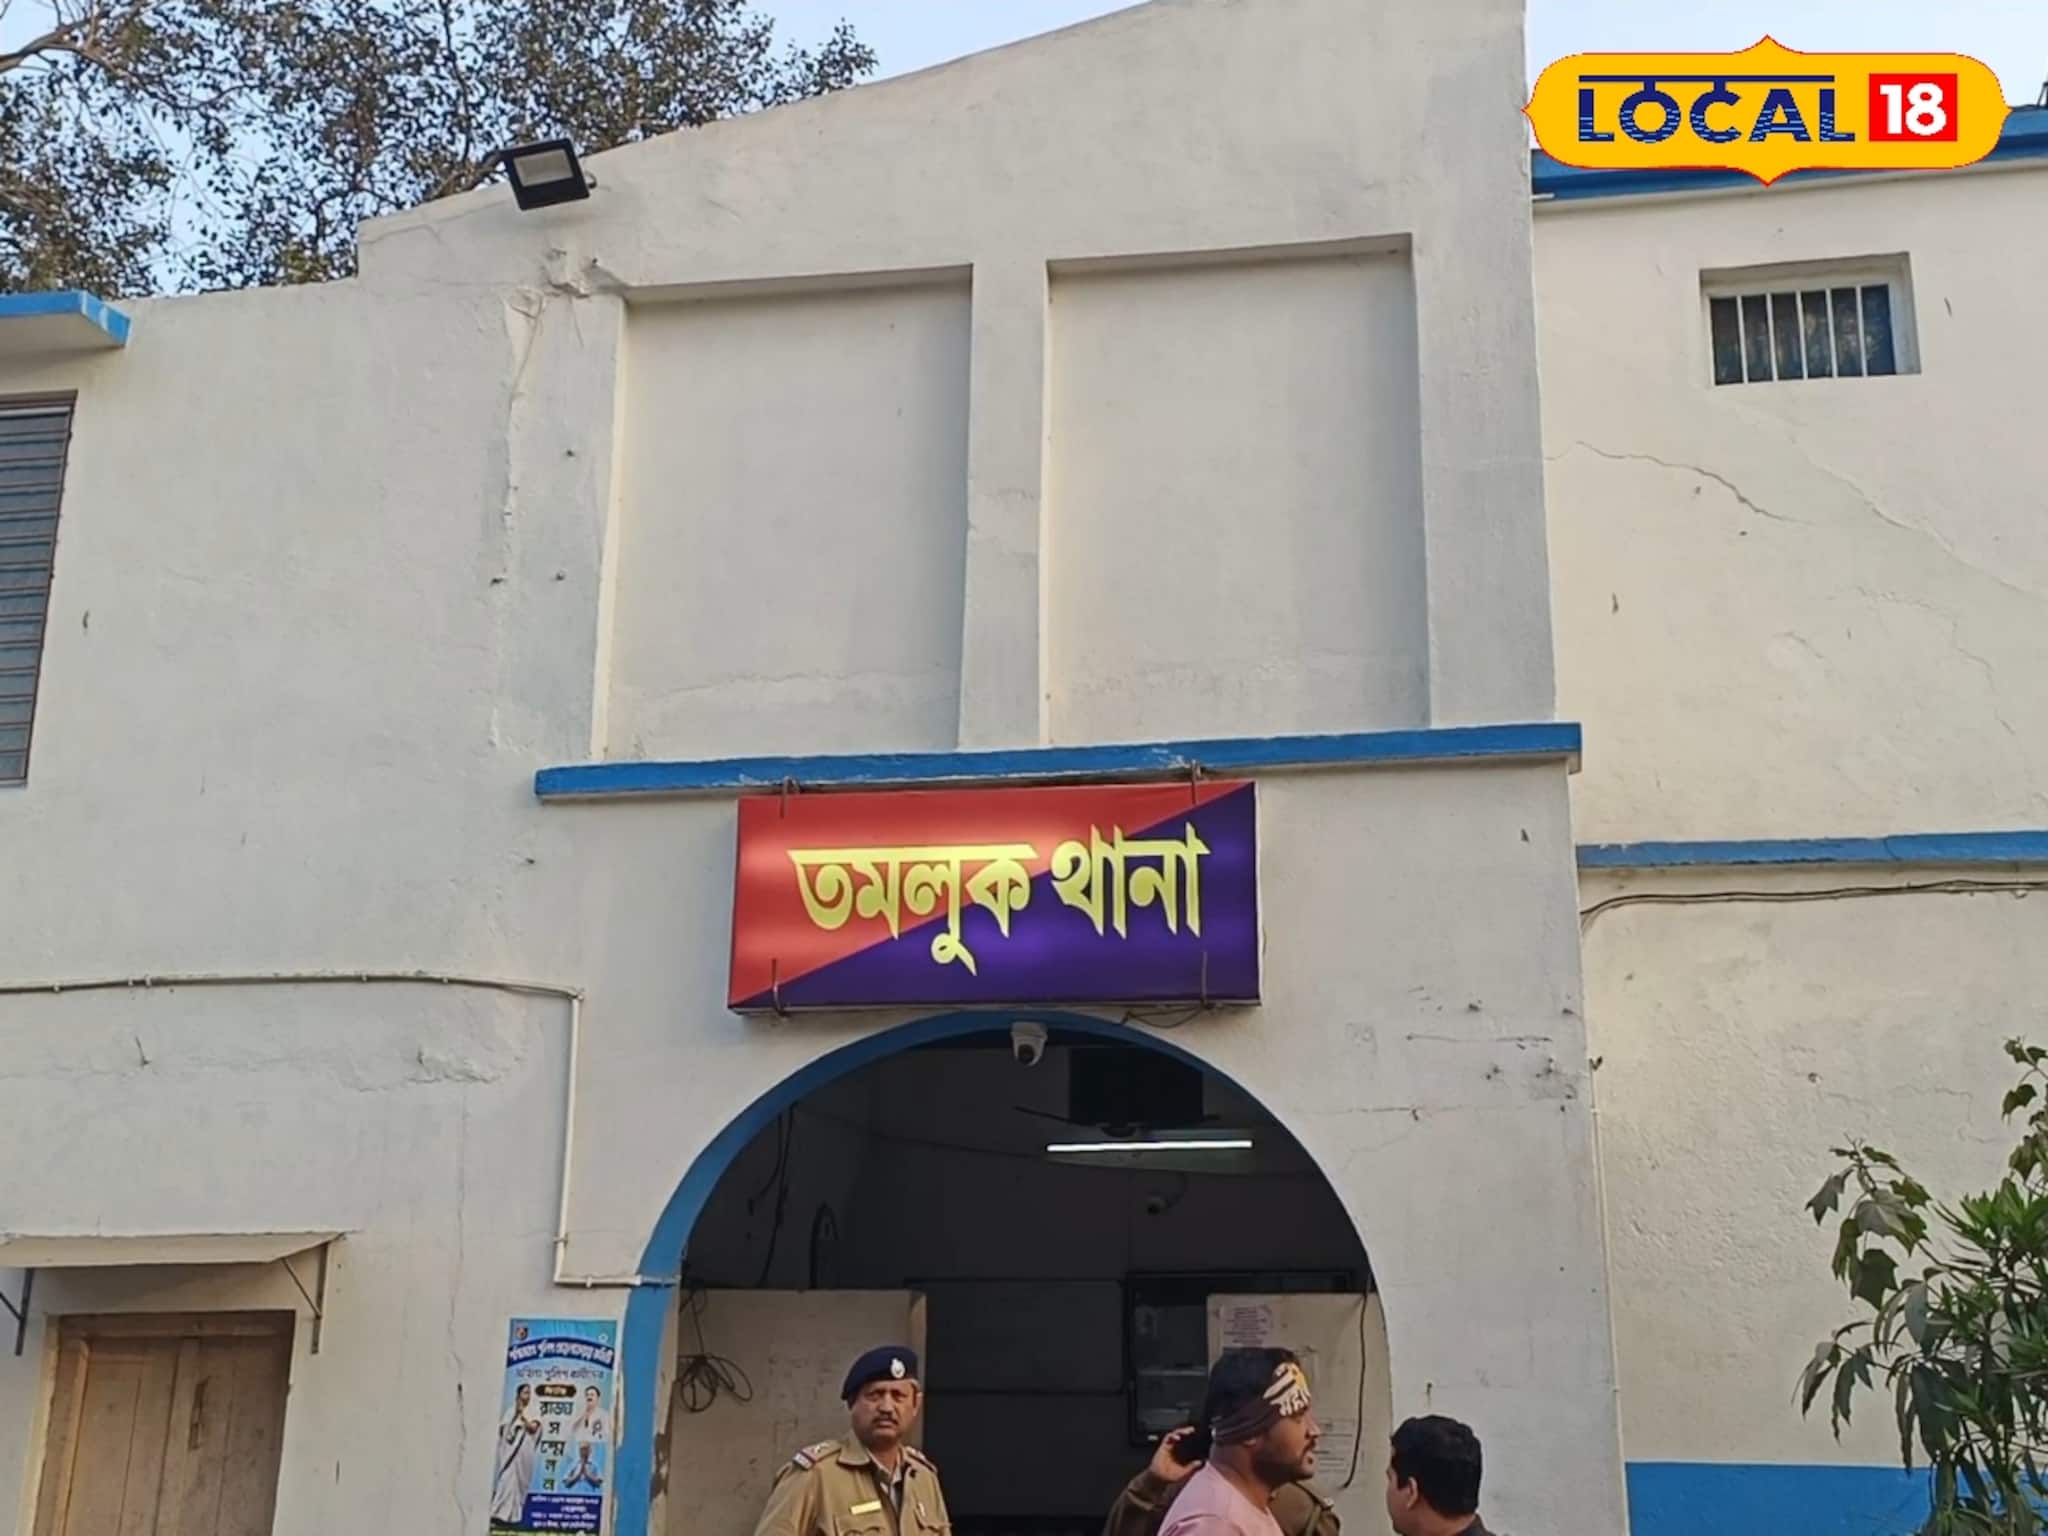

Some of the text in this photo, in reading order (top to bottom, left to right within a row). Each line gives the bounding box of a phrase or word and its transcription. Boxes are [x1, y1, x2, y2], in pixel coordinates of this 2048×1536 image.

[787, 821, 1212, 975] তমলুক থানা
[539, 1401, 573, 1416] রাজ্য
